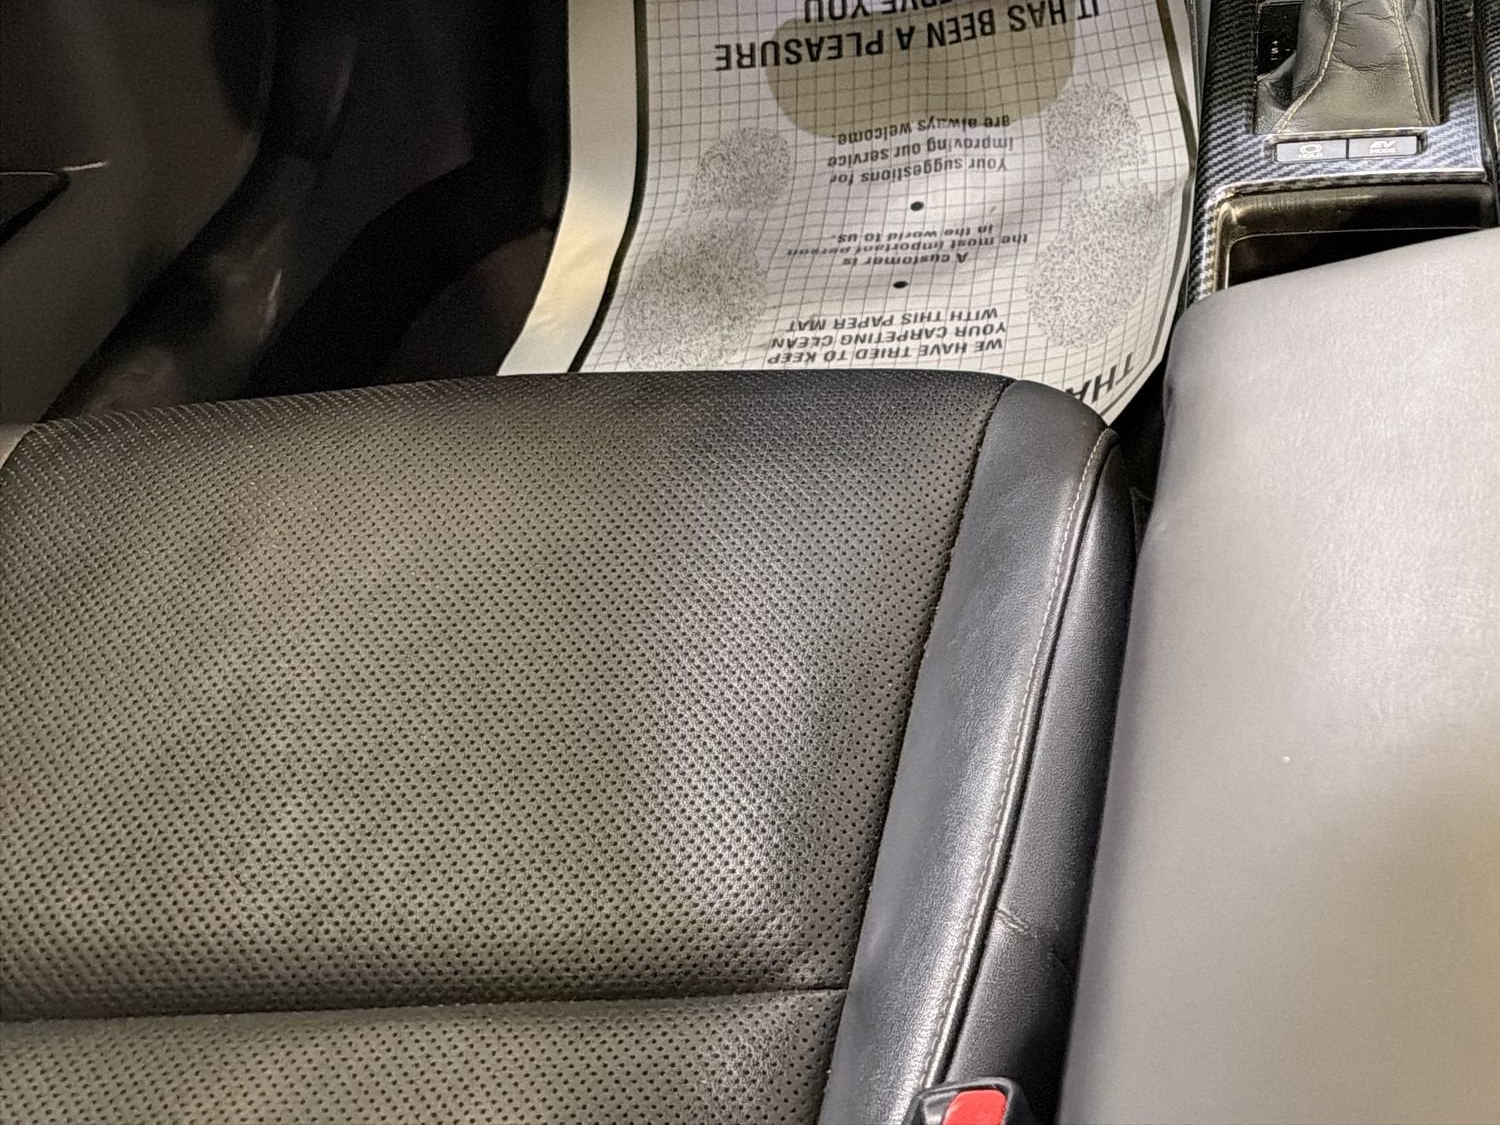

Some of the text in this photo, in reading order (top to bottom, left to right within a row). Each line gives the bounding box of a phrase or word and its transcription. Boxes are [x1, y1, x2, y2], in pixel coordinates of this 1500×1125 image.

[896, 26, 916, 50] A
[927, 8, 996, 49] BEEN
[714, 30, 884, 71] PLEASURE
[832, 114, 1010, 145] are always welcome.
[828, 137, 1014, 167] improving our service
[1370, 140, 1396, 148] EV
[830, 156, 1008, 186] Your suggestions for
[864, 232, 882, 242] to
[887, 229, 938, 240] world
[944, 226, 970, 236] the
[977, 224, 994, 234] in
[855, 239, 944, 254] important
[950, 236, 994, 250] most
[1002, 234, 1028, 244] the
[843, 252, 969, 266] A customer is
[786, 307, 998, 333] WITH THIS PAPER MAT
[770, 322, 1008, 349] YOUR CARPETING CLEAN
[767, 338, 1003, 366] WE HAVE TRIED TO KEEP
